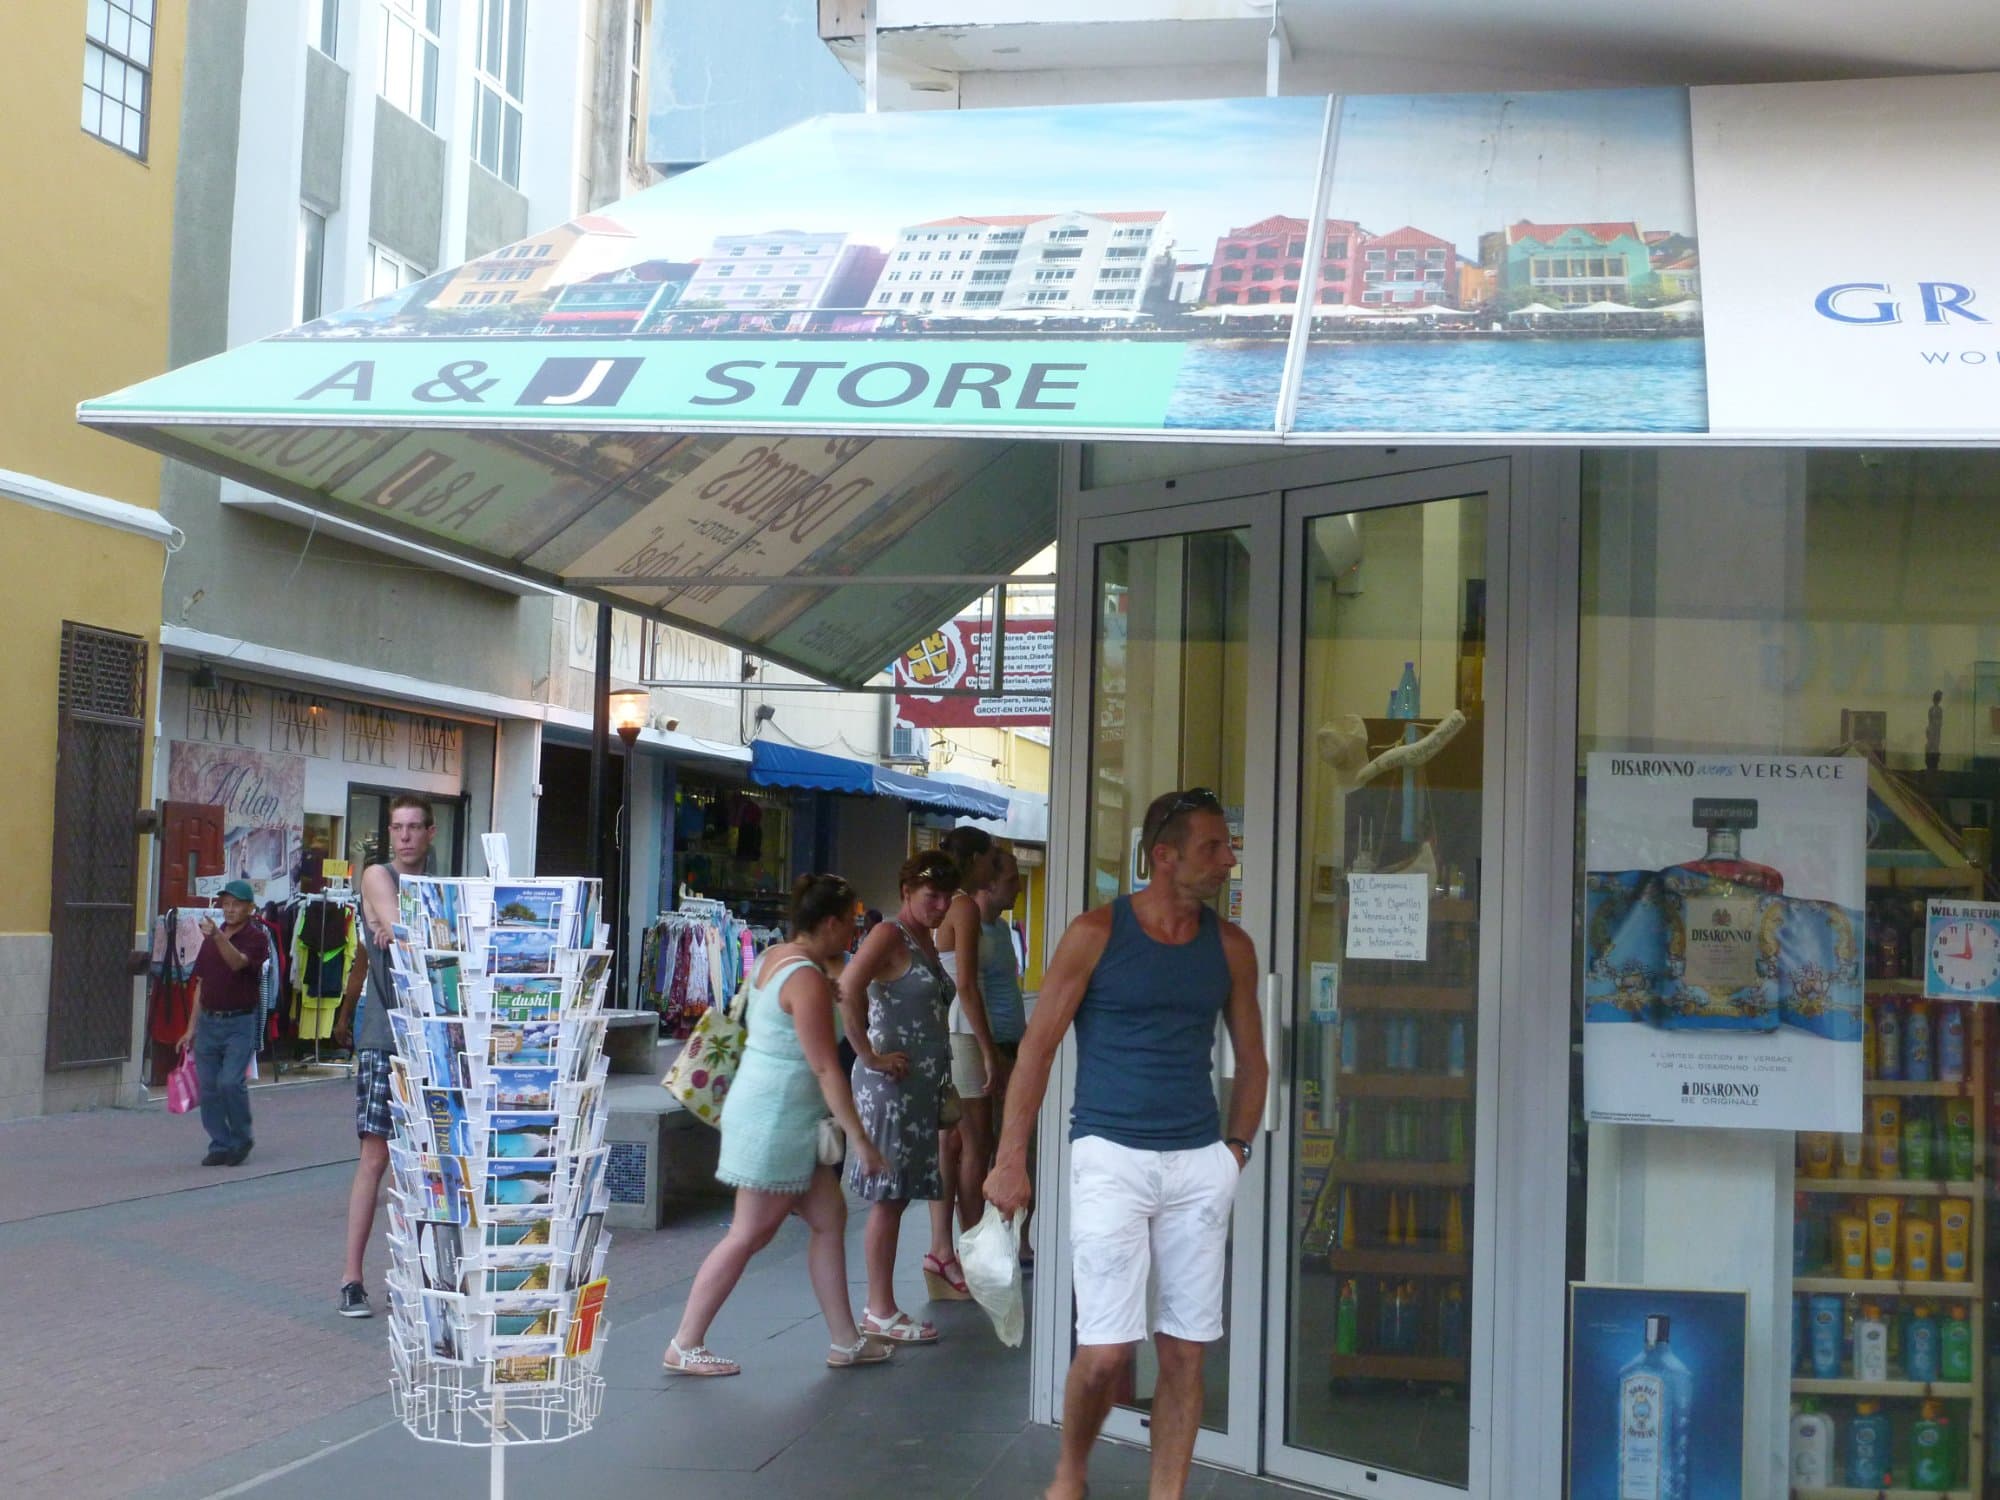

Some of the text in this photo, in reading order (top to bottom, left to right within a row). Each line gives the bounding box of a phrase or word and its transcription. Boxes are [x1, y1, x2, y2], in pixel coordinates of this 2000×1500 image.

[1920, 351, 2000, 365] WO
[297, 359, 1087, 410] A & J STORE
[1611, 759, 1694, 778] DISARONNO
[1740, 763, 1844, 780] VERSACE
[1931, 906, 1958, 916] WILL
[1691, 928, 1752, 942] DISARONNO
[1692, 1082, 1759, 1098] DISARONNO
[1702, 1097, 1759, 1106] ORIGINALE
